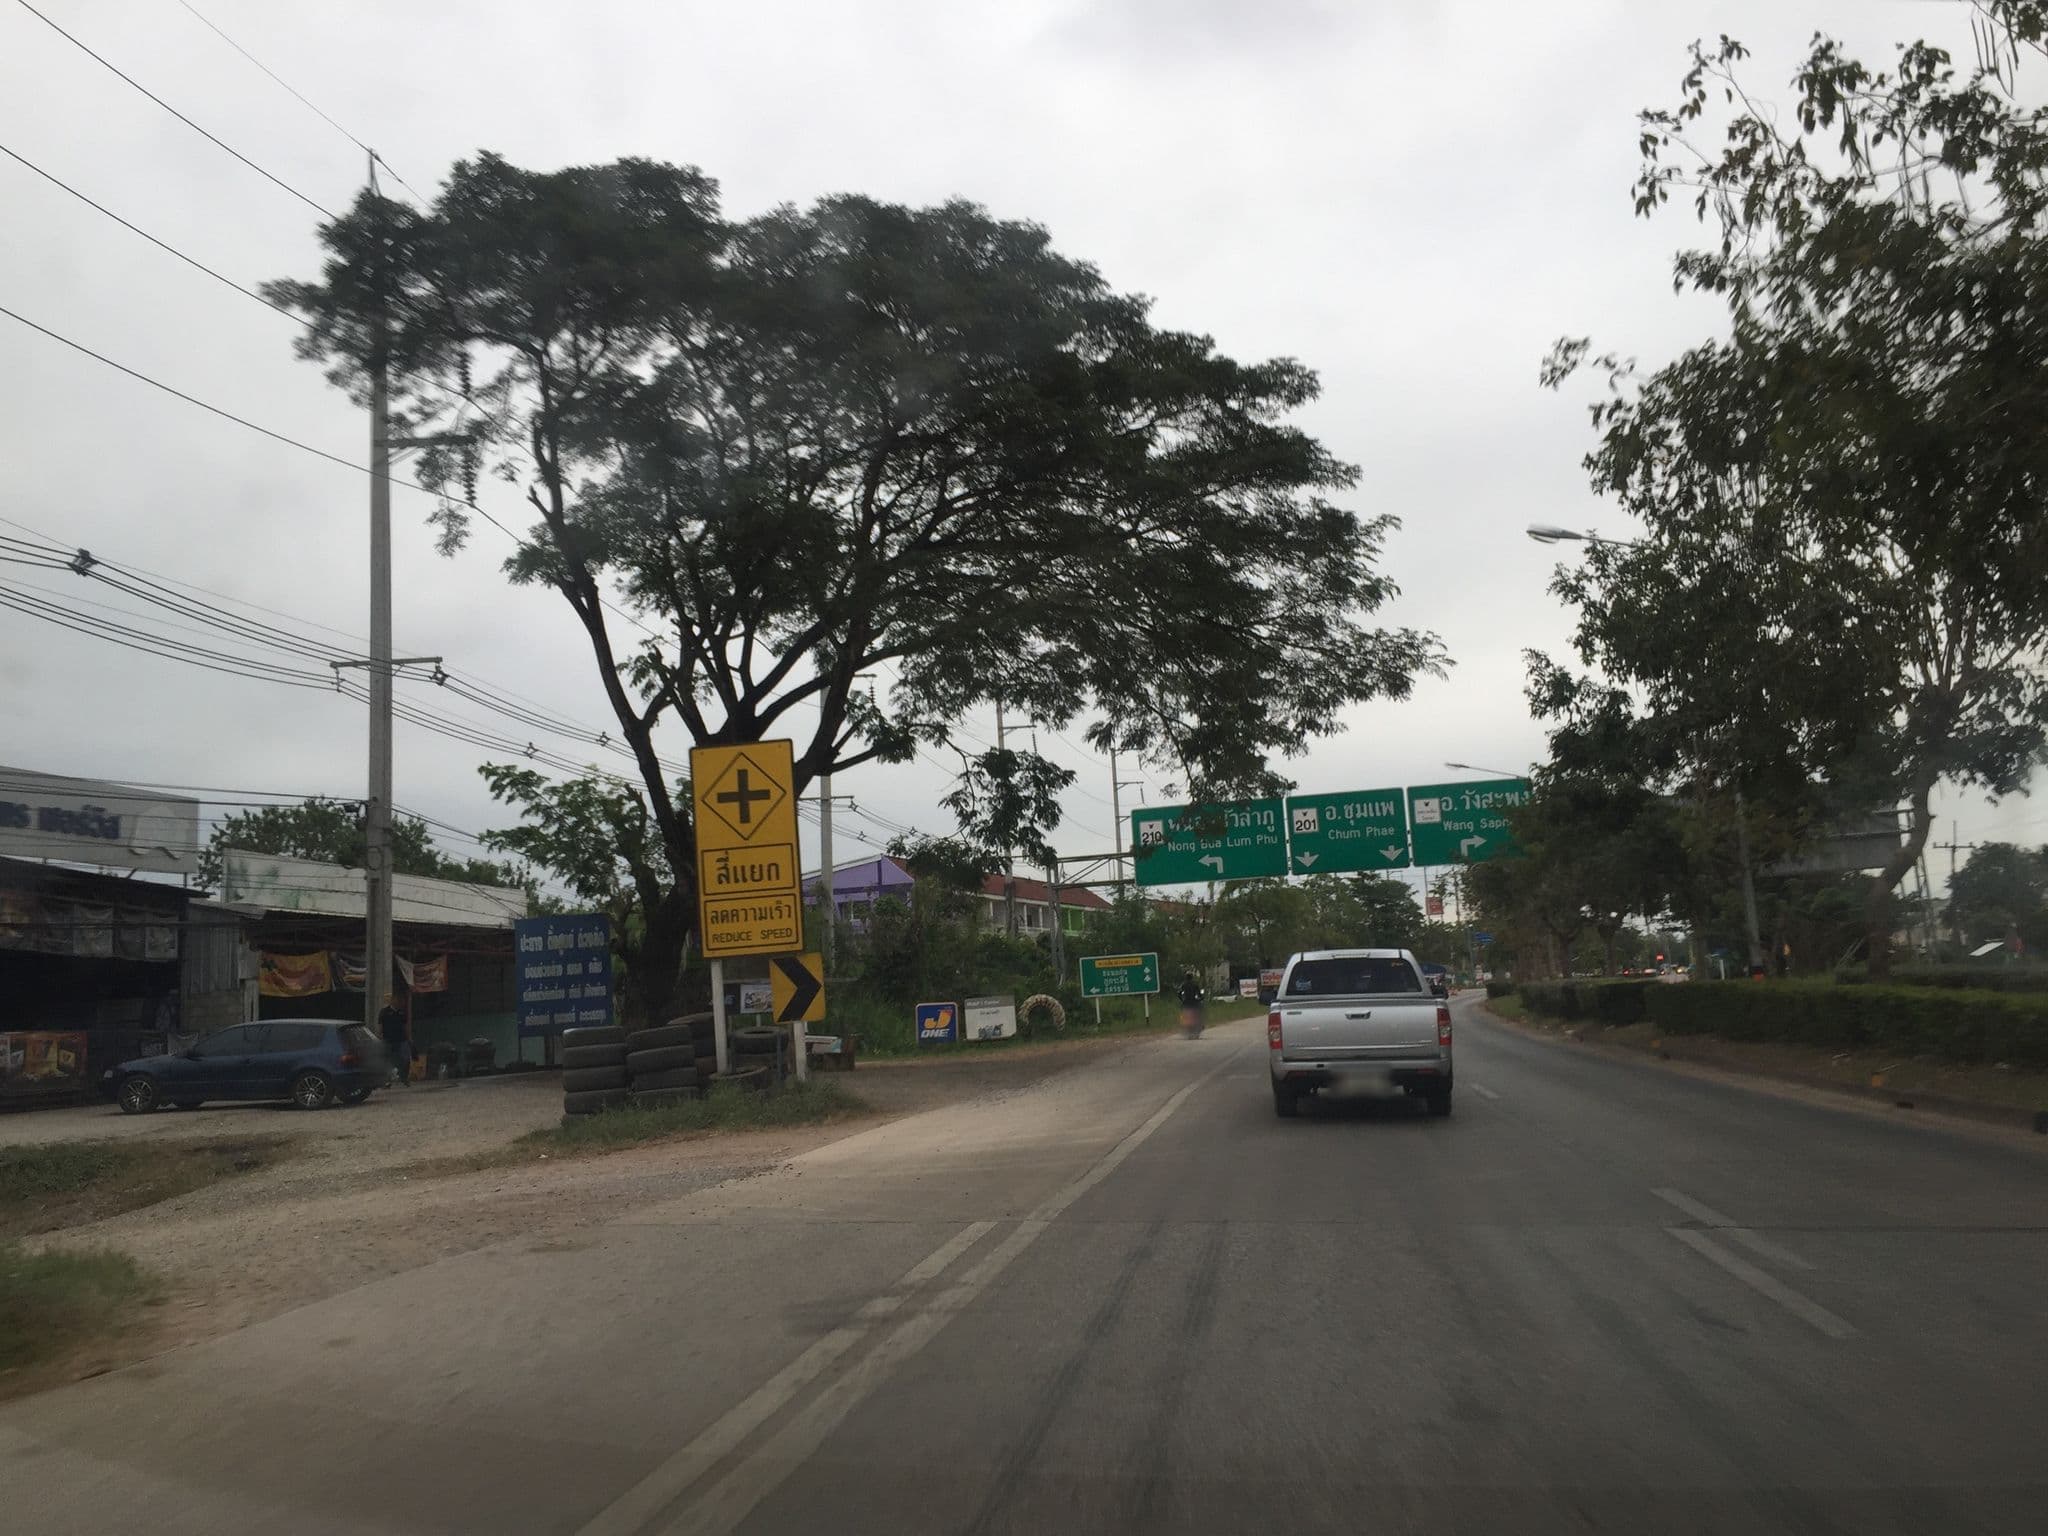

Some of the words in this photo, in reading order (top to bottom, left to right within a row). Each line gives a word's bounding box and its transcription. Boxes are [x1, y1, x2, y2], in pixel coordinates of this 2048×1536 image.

[1295, 819, 1317, 832] 201
[1328, 829, 1361, 840] Chum
[1365, 826, 1395, 838] Phae
[1443, 820, 1474, 832] Wang
[1142, 831, 1162, 846] 210
[1168, 841, 1196, 853] Nong
[1227, 837, 1251, 848] Lum
[1256, 834, 1278, 846] Phu
[716, 851, 780, 885] สี่แยก
[710, 900, 792, 925] ลดความเร็ว
[712, 931, 752, 944] REDUCE
[760, 928, 793, 940] SPEED
